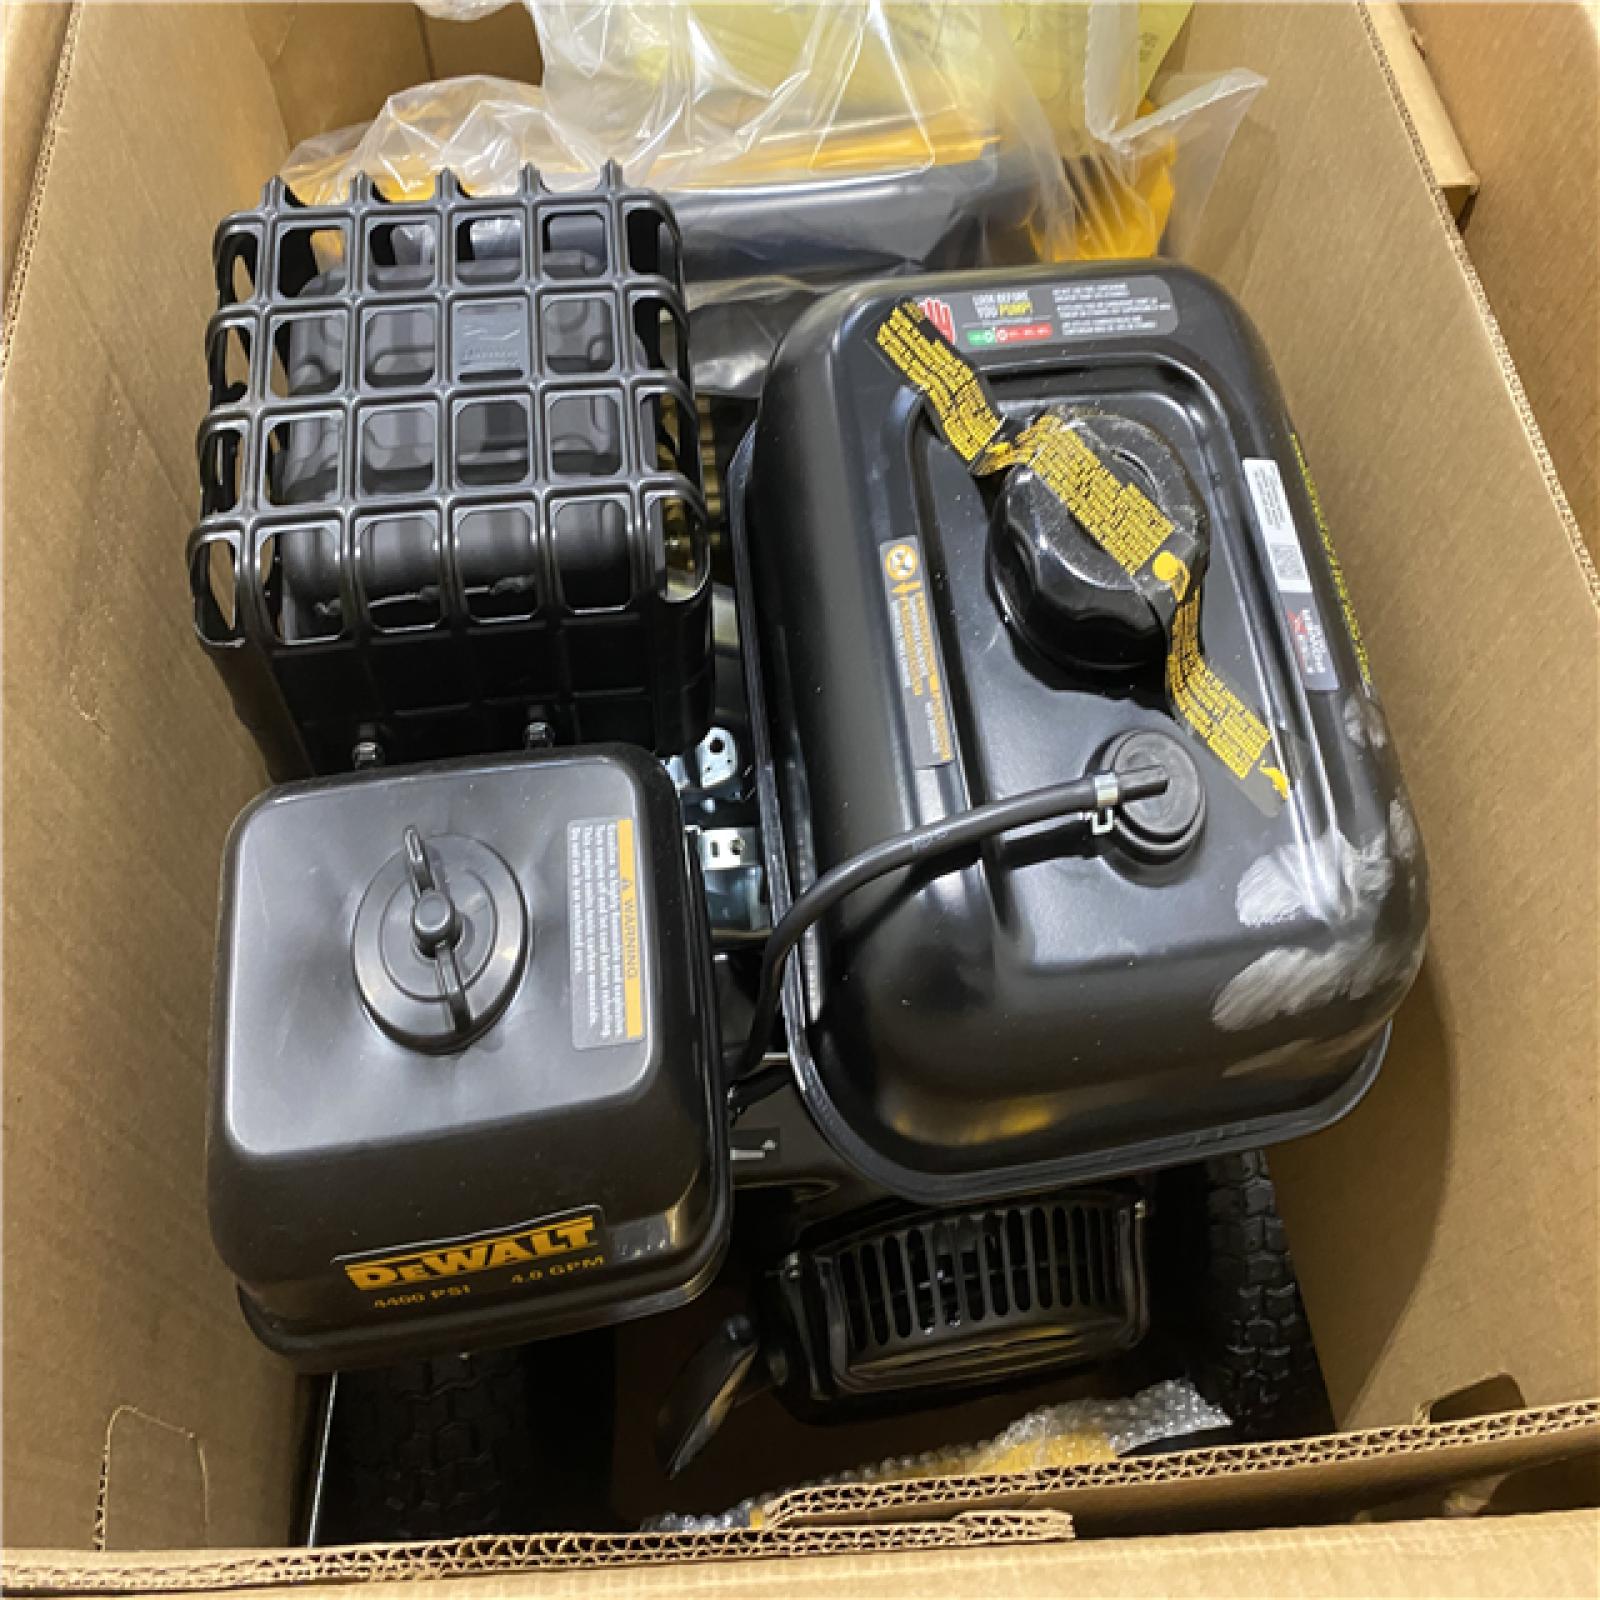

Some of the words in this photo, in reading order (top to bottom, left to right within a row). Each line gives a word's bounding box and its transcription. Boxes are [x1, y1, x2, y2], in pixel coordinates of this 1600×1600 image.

[622, 899, 638, 980] WARNING
[345, 1215, 594, 1291] DEWALT
[549, 1254, 604, 1276] GPM
